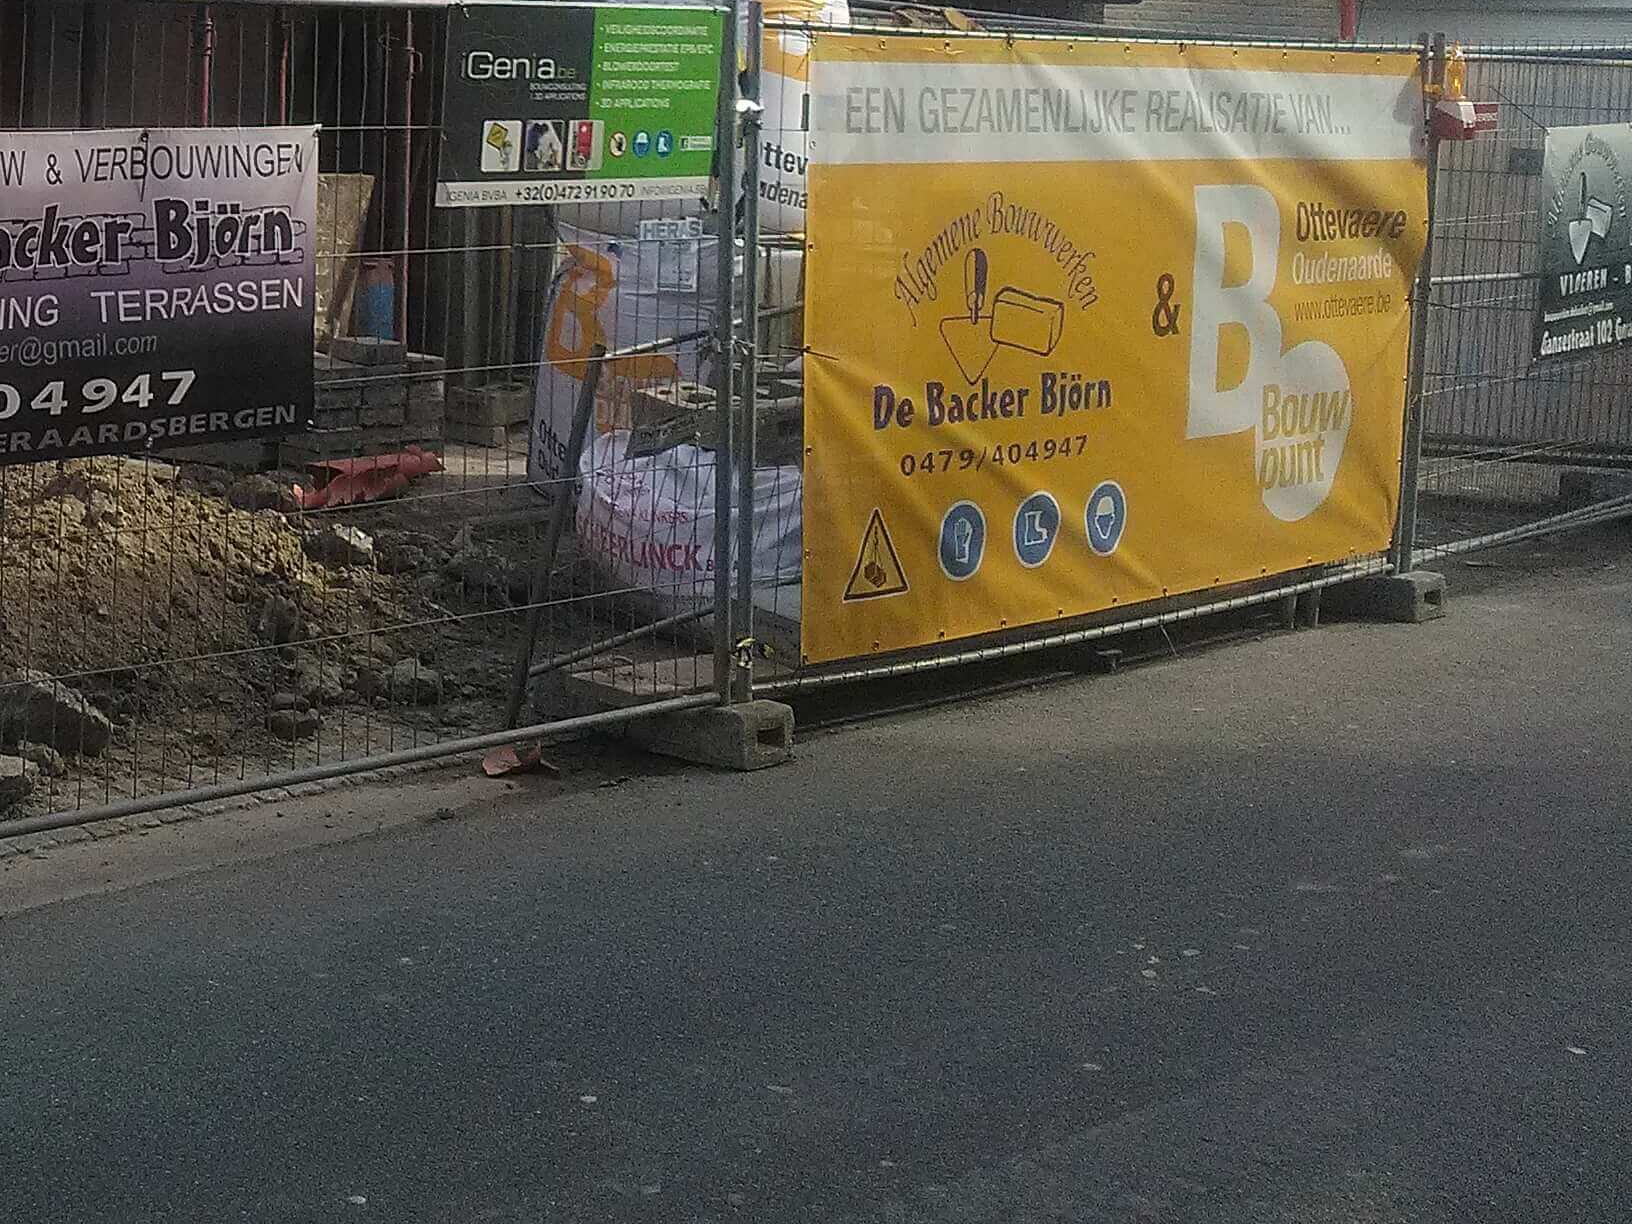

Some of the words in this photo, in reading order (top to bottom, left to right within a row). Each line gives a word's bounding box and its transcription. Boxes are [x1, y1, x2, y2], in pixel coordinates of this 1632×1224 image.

[845, 87, 905, 134] EEN
[919, 86, 1138, 134] GEZAMENLIJKE
[1144, 90, 1287, 134] REALISATIE
[45, 153, 63, 186] &
[74, 142, 304, 182] VERBOUWINGEN
[516, 183, 582, 202] +32(0)472
[584, 184, 597, 199] 91
[599, 184, 617, 198] 90
[619, 184, 635, 198] 70
[152, 195, 296, 268] Björn
[1295, 200, 1408, 243] Ottevaere
[894, 207, 981, 327] Algemene
[986, 190, 1099, 311] Bouwwerken
[1292, 248, 1393, 286] Oudenaarde
[89, 277, 304, 324] TERRASSEN
[1151, 273, 1181, 337] &
[1294, 290, 1392, 323] www.ottevaere.be
[872, 383, 916, 431] De
[925, 376, 1030, 427] Backer
[1040, 371, 1113, 417] Björn
[900, 434, 1089, 477] 0479/404947
